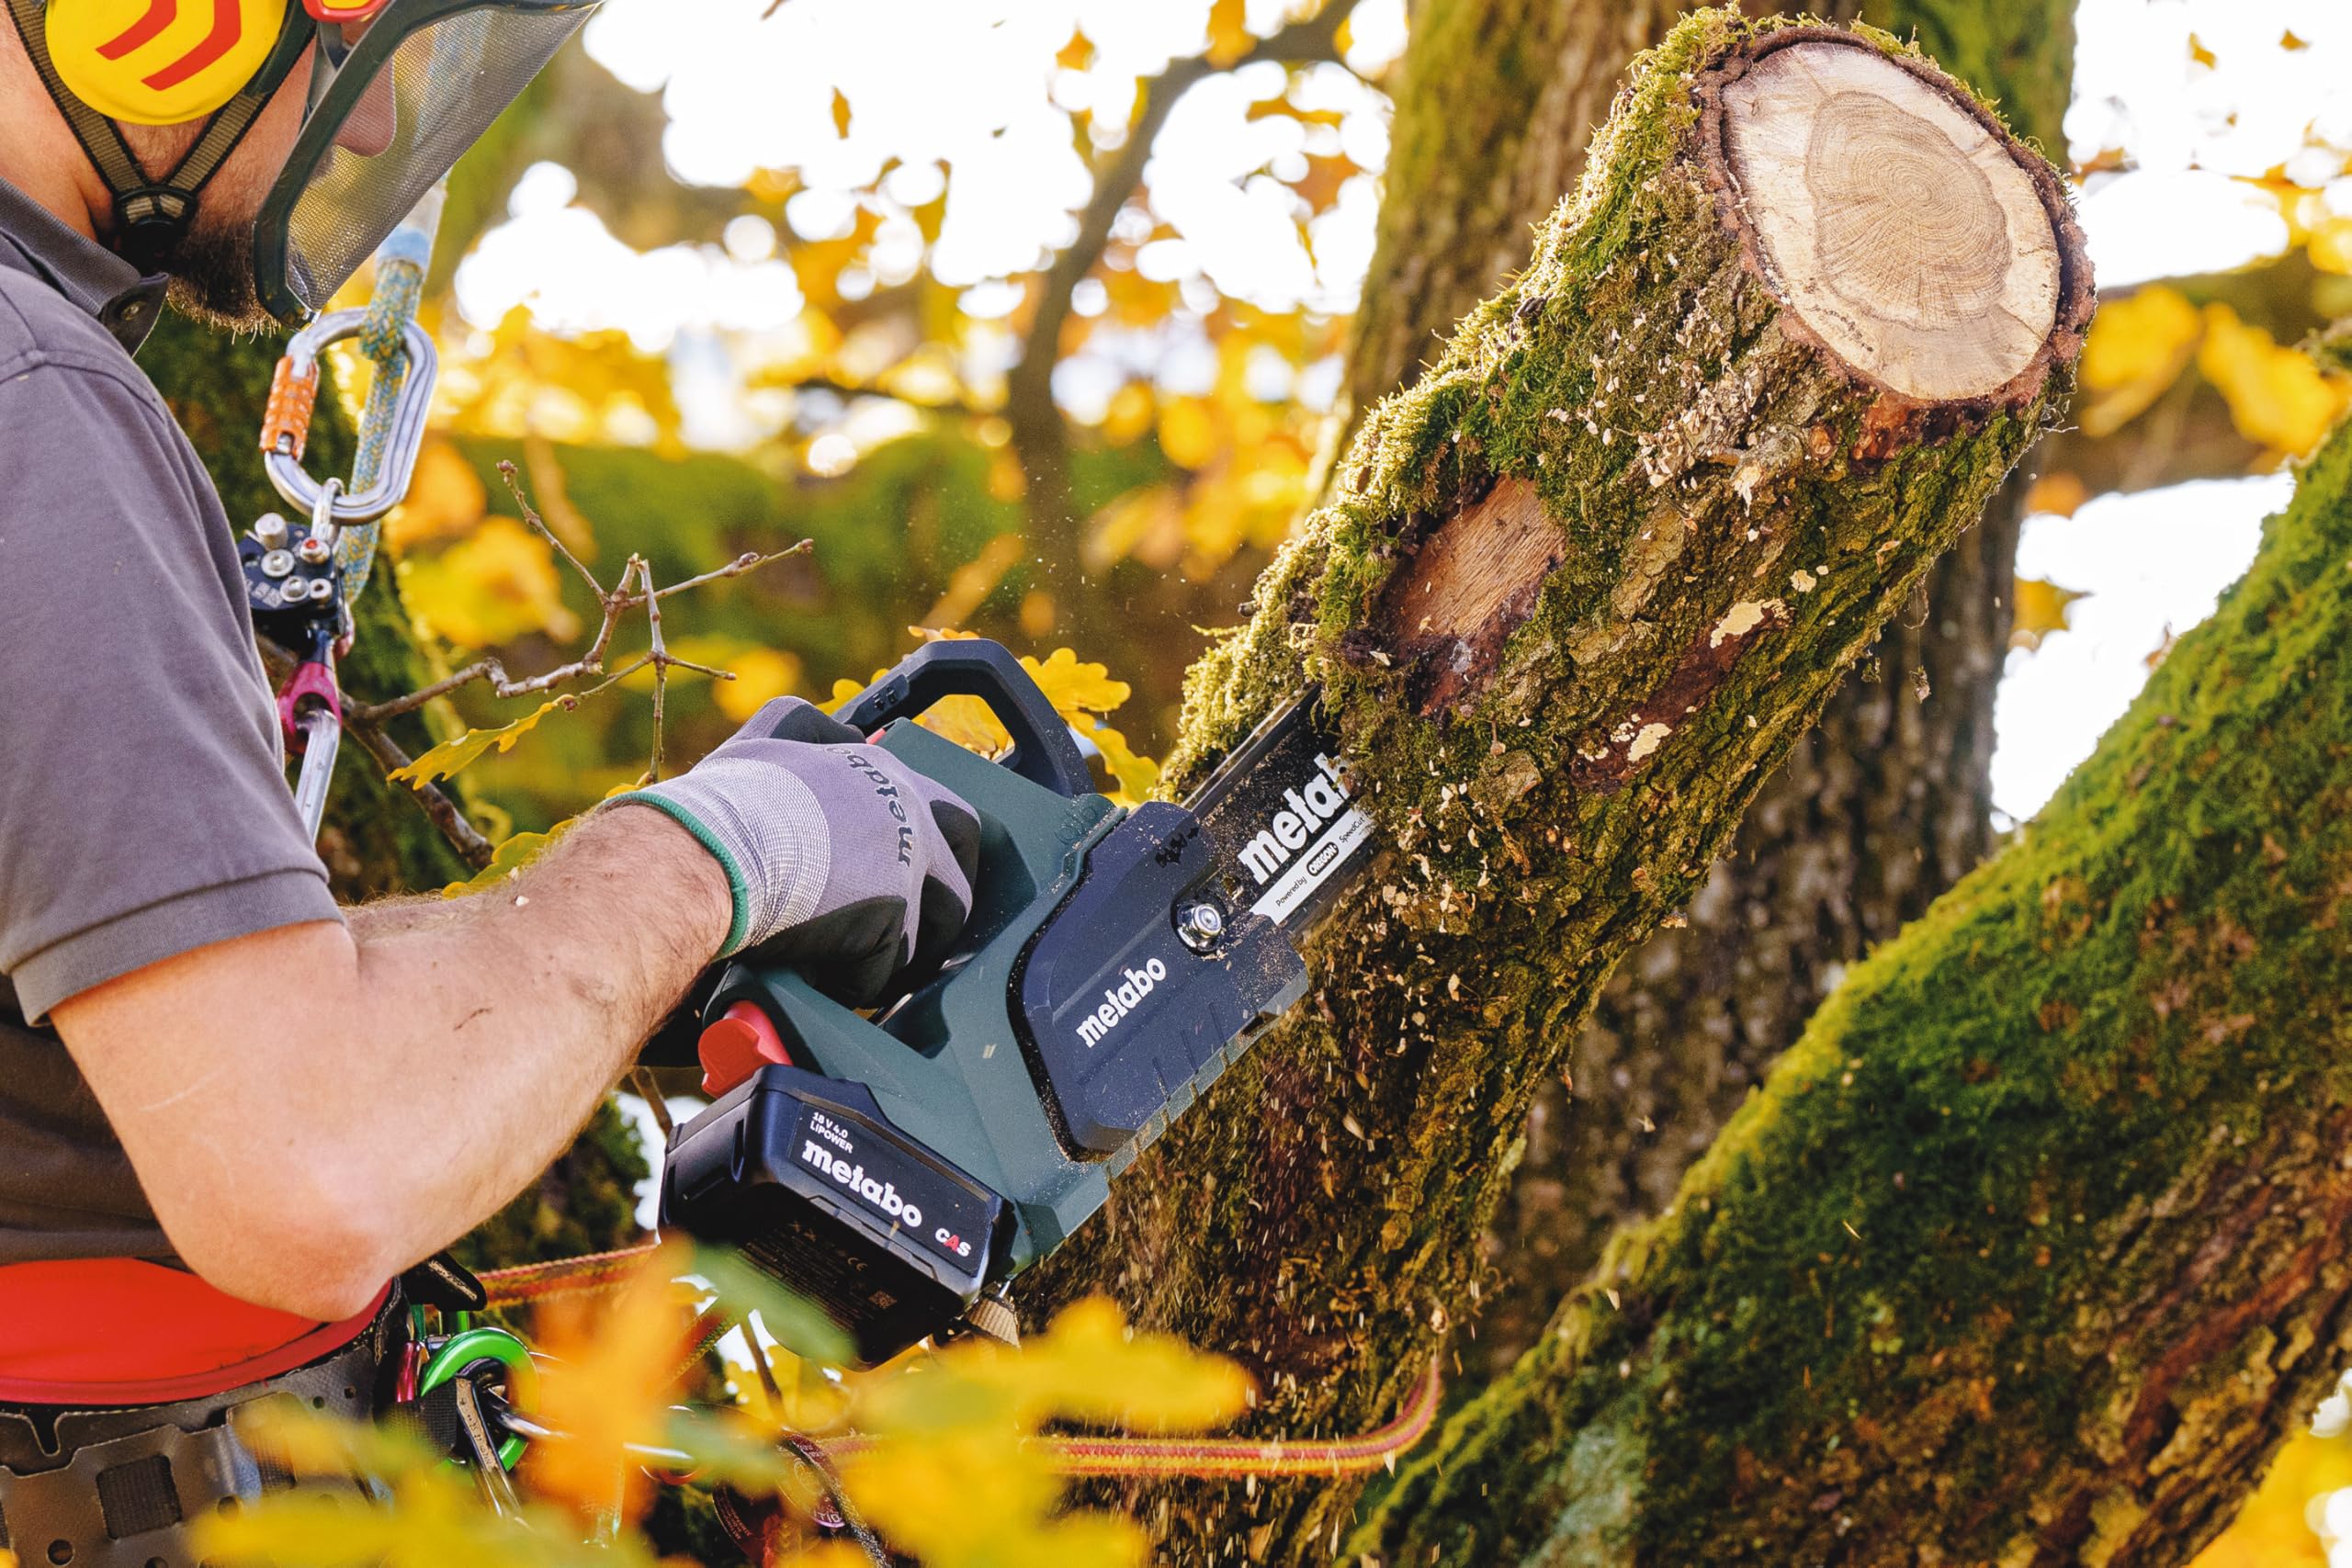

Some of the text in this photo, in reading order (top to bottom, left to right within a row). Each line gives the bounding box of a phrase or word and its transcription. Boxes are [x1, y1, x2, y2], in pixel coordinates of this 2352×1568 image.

[825, 747, 913, 868] metabo
[1238, 752, 1351, 886] metab
[1276, 883, 1300, 907] Powered
[1298, 876, 1307, 887] by
[1308, 844, 1337, 874] OREGON
[1339, 816, 1365, 843] SpeedCut
[1076, 958, 1167, 1048] metabo
[809, 1120, 854, 1154] LIPOWER
[812, 1111, 848, 1139] 18 V 4.0
[801, 1139, 922, 1228] metabo
[934, 1227, 972, 1258] CAS
